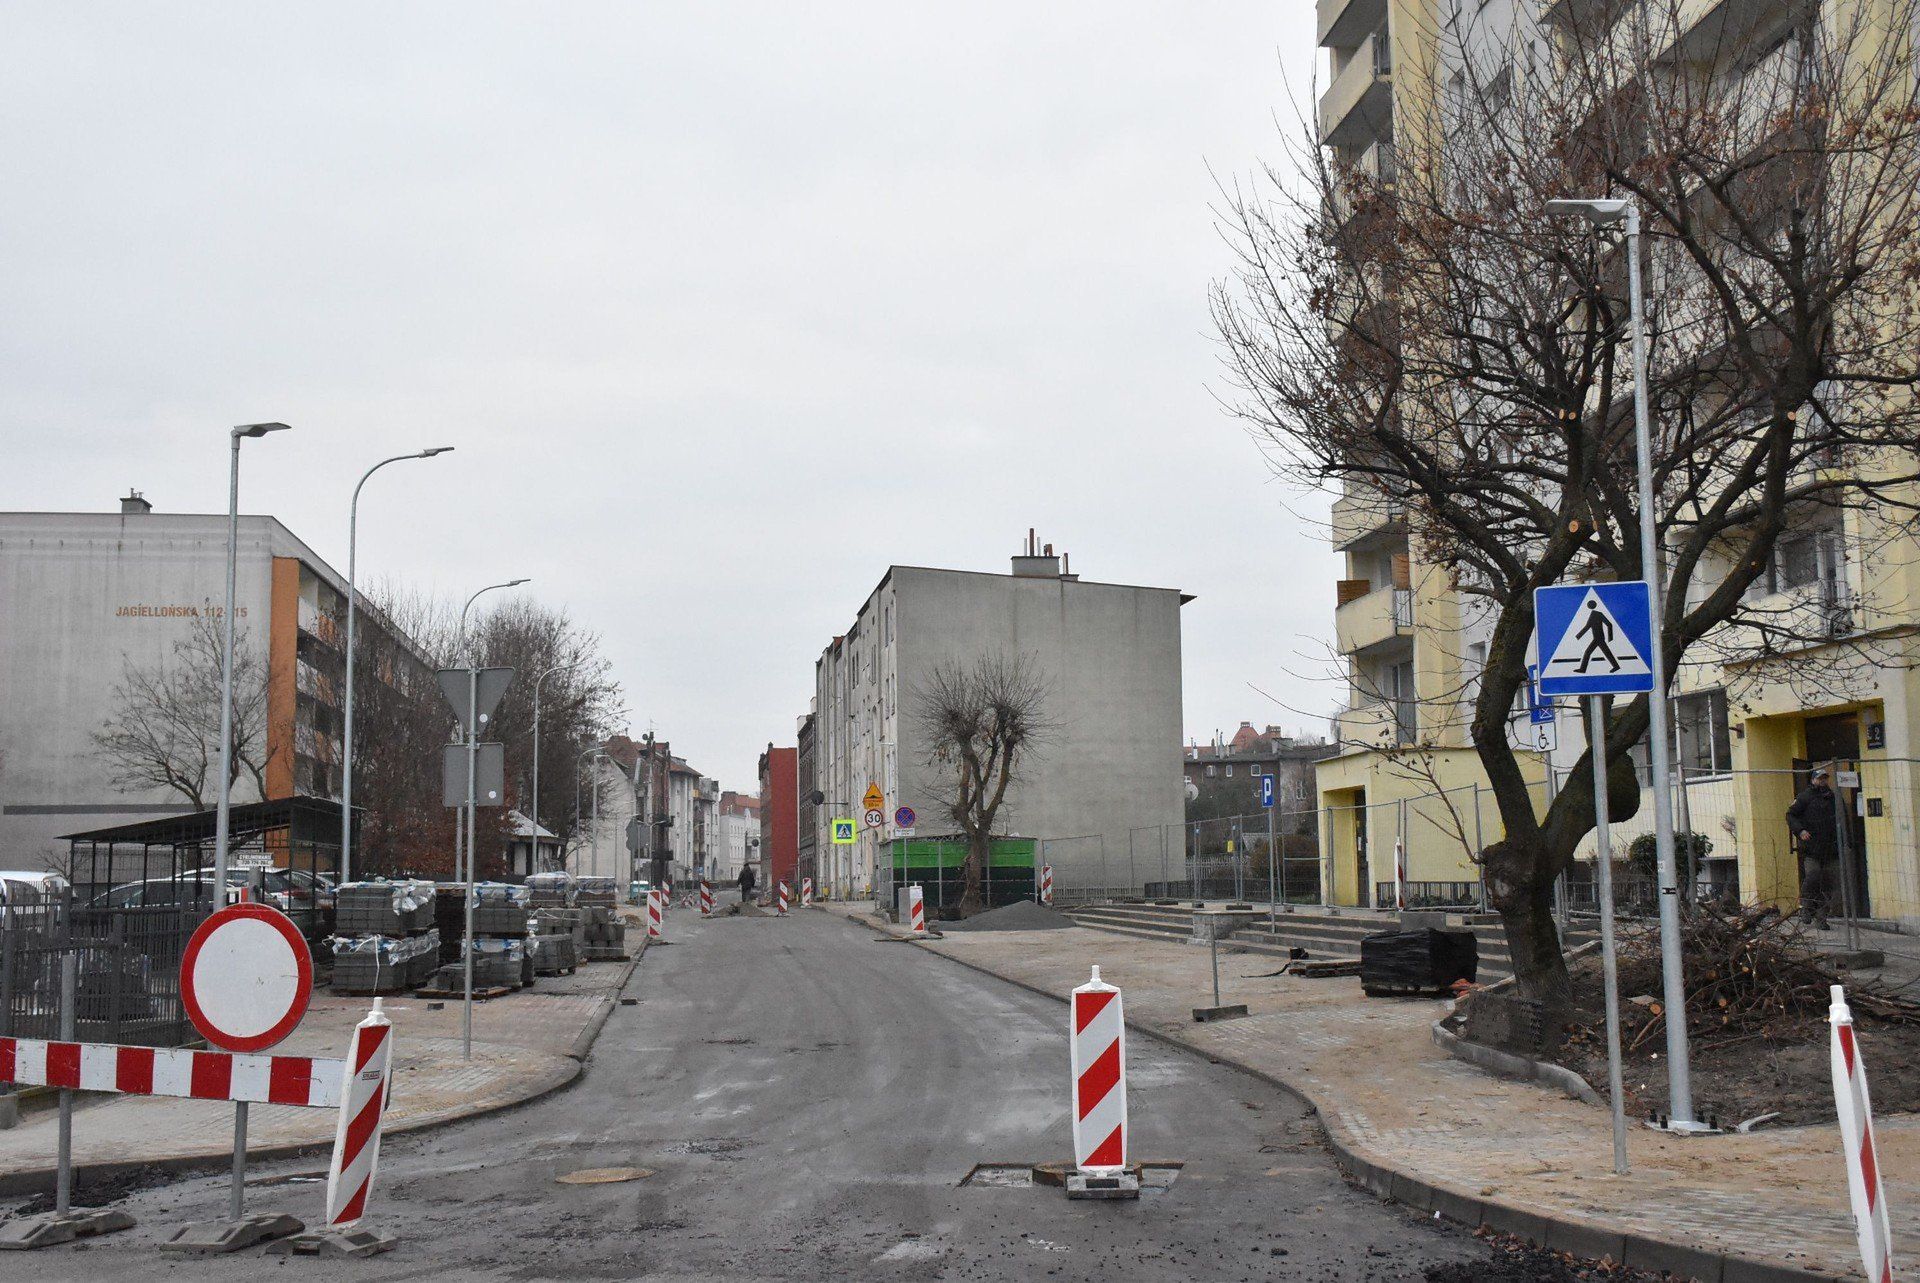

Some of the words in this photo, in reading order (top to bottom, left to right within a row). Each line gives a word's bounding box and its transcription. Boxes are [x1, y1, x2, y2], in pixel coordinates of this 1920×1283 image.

[203, 606, 248, 618] 112-15
[1264, 778, 1272, 803] P
[867, 813, 881, 823] 30
